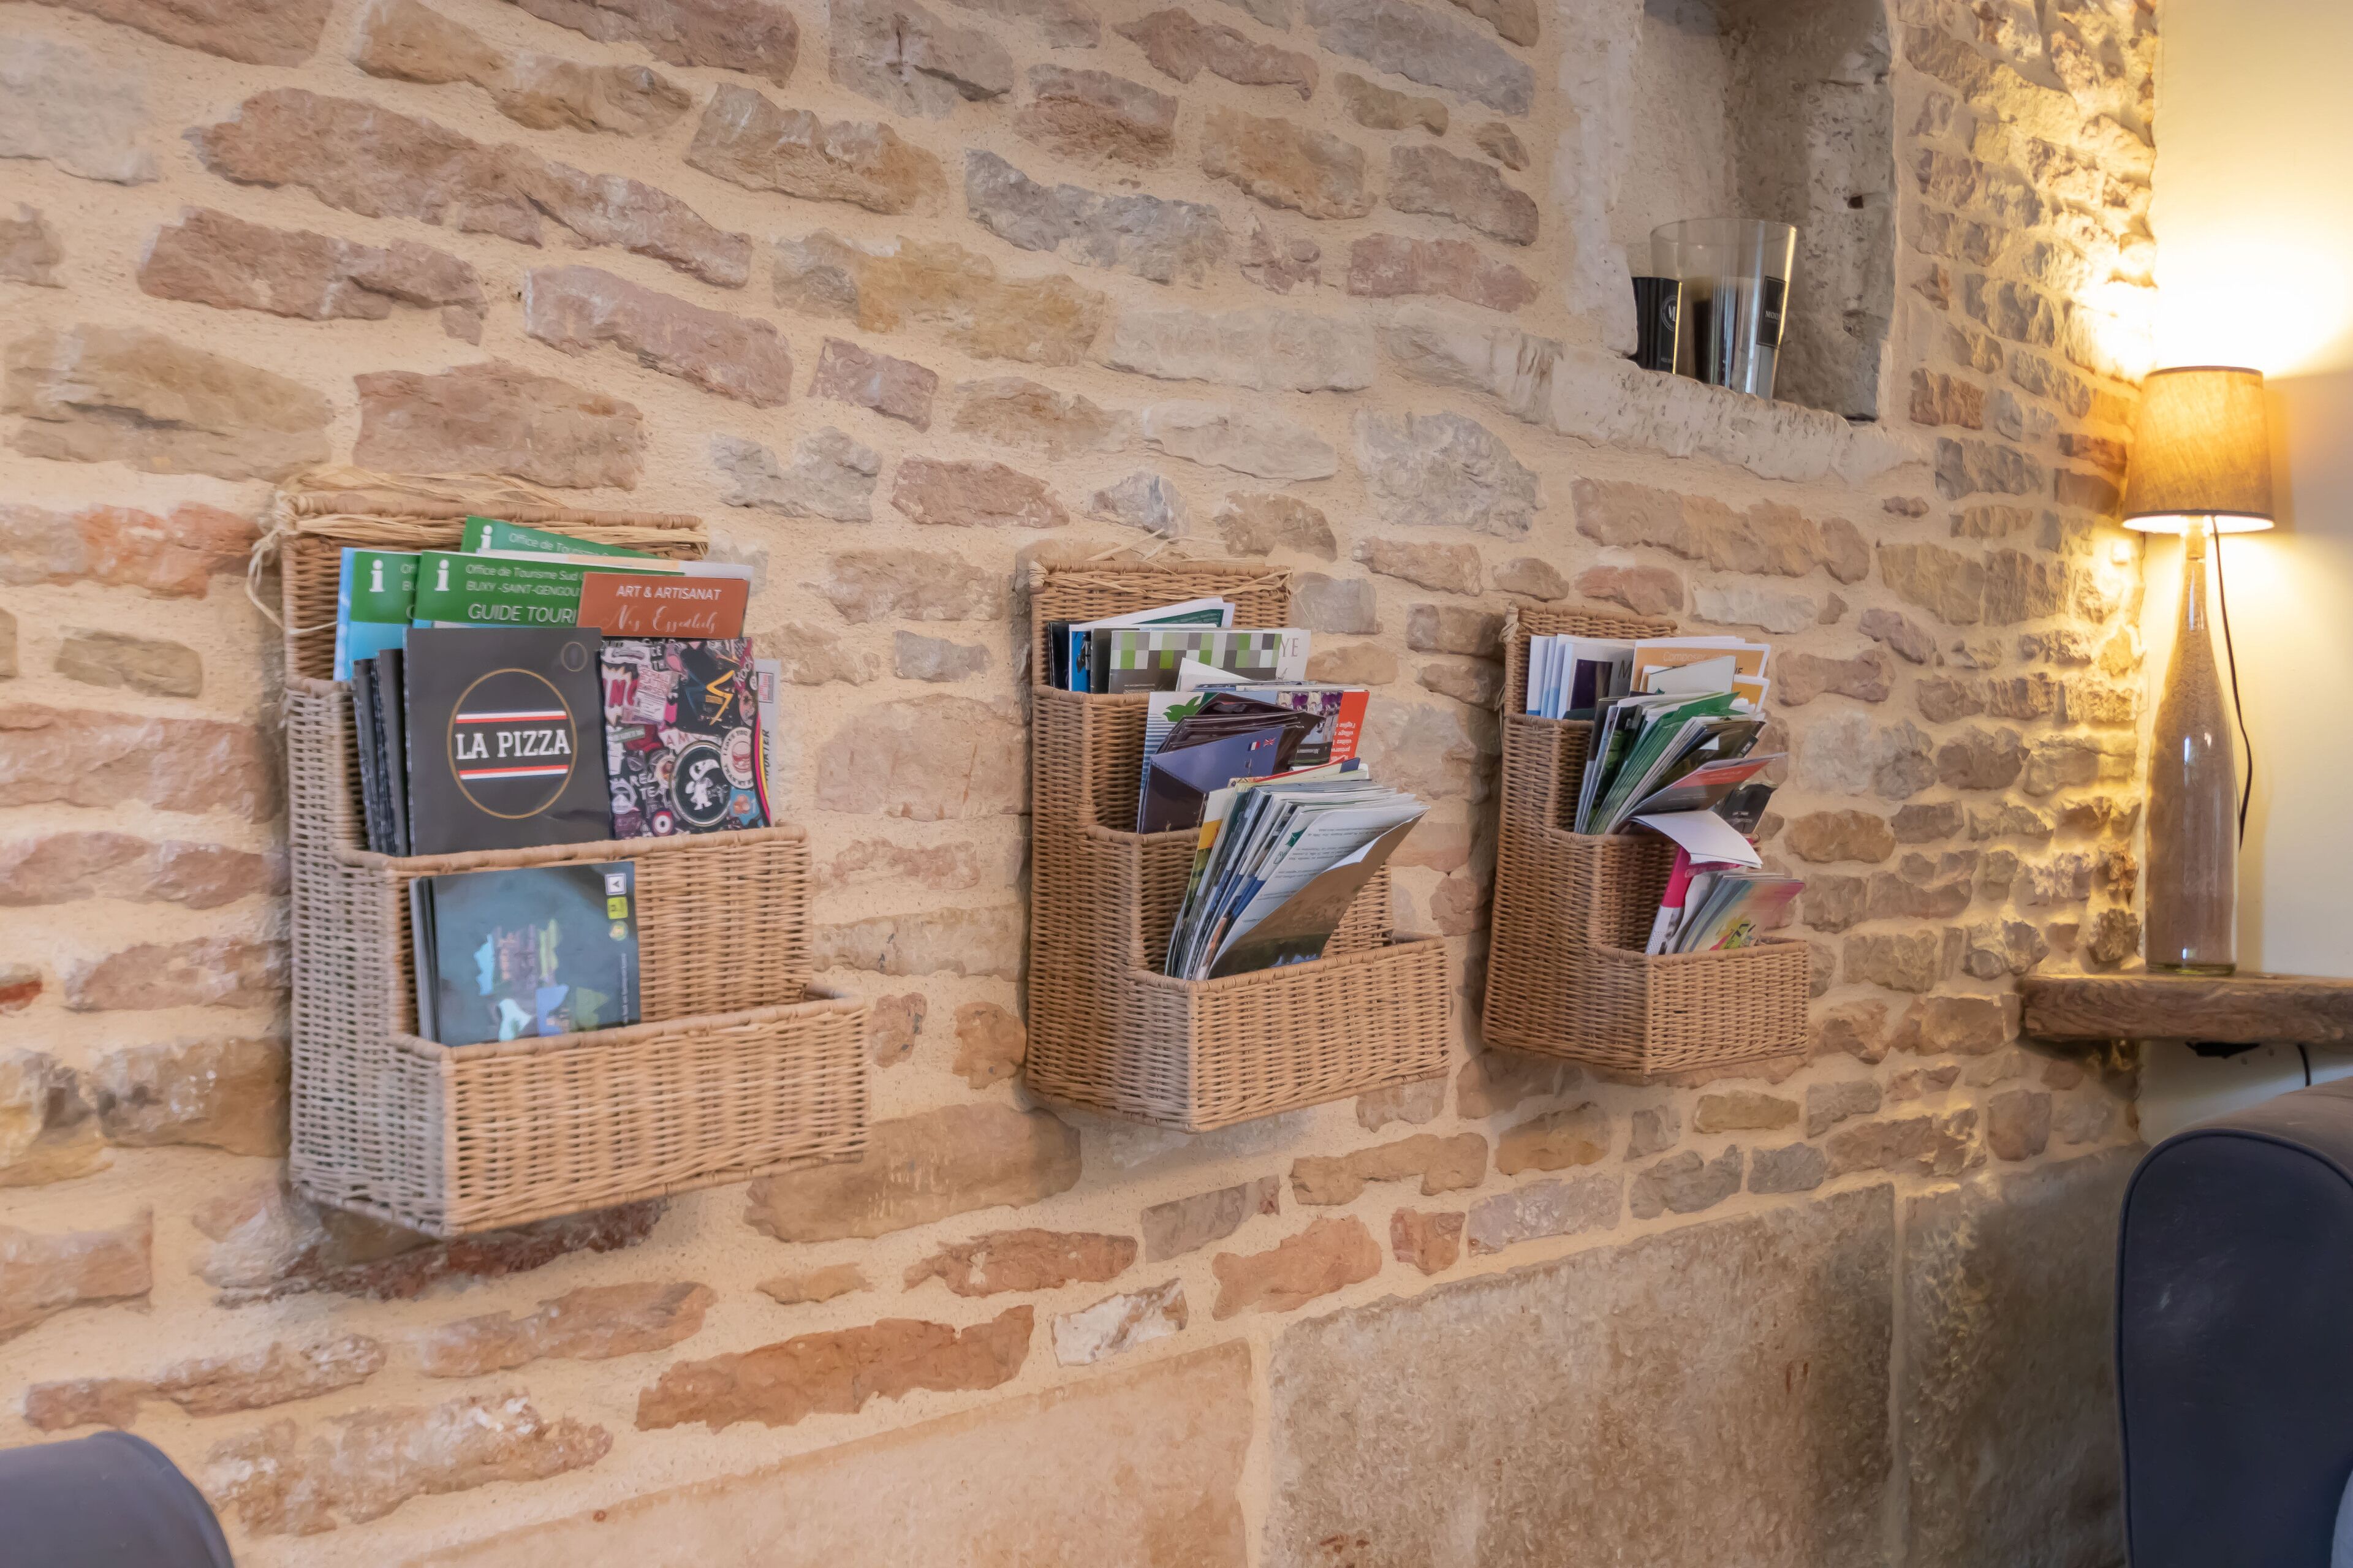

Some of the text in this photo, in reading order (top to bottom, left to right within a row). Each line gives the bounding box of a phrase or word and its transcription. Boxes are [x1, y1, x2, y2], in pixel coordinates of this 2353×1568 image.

[508, 533, 539, 547] Office
[539, 538, 553, 550] de
[466, 564, 496, 574] Office
[497, 564, 512, 577] de
[513, 567, 558, 580] Tourisme
[559, 570, 578, 581] Sud
[466, 581, 495, 592] BUXY
[616, 585, 722, 600] ART & ARTISANAT
[468, 603, 577, 624] GUIDE TOURI
[455, 729, 572, 760] LA PIZZA
